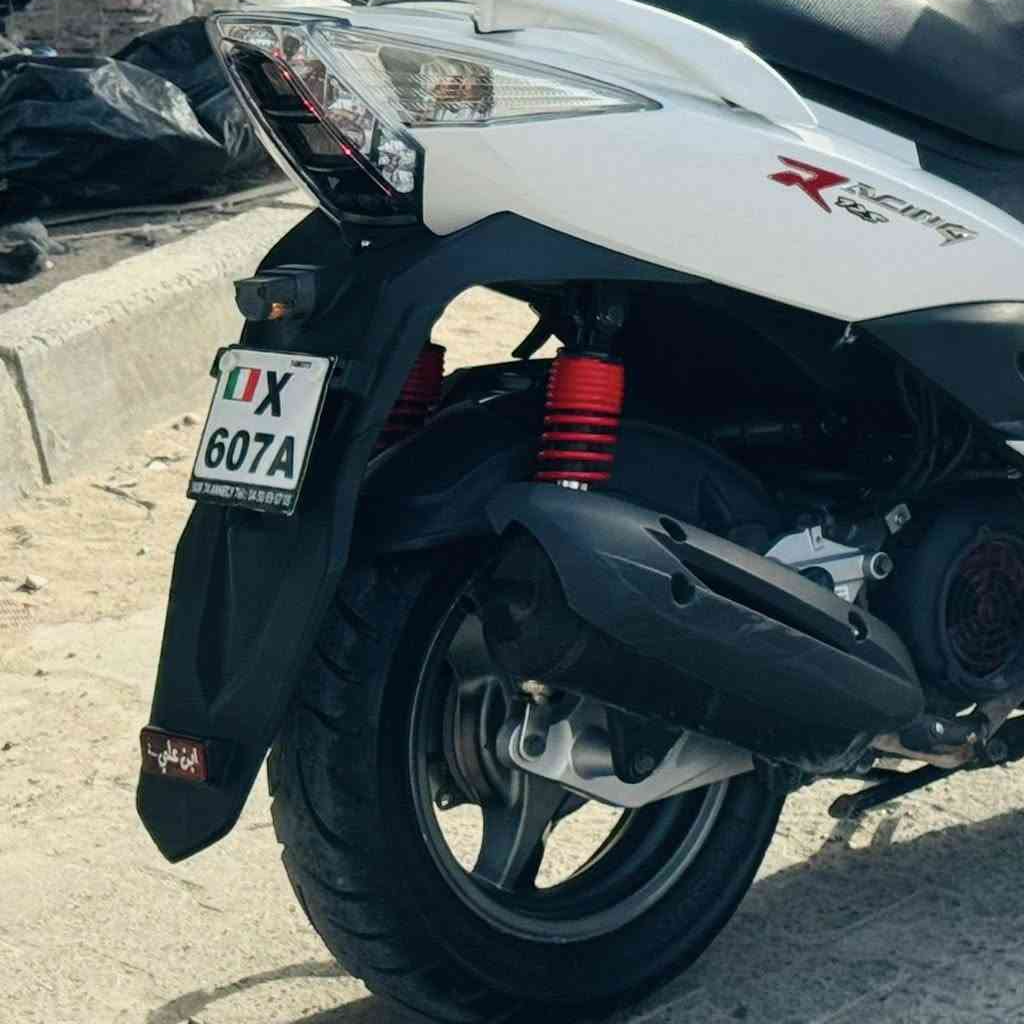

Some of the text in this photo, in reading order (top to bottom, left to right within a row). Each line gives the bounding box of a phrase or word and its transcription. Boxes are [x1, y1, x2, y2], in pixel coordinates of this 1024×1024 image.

[254, 371, 294, 418] X
[204, 427, 295, 479] 607A
[180, 747, 199, 773] ابن
